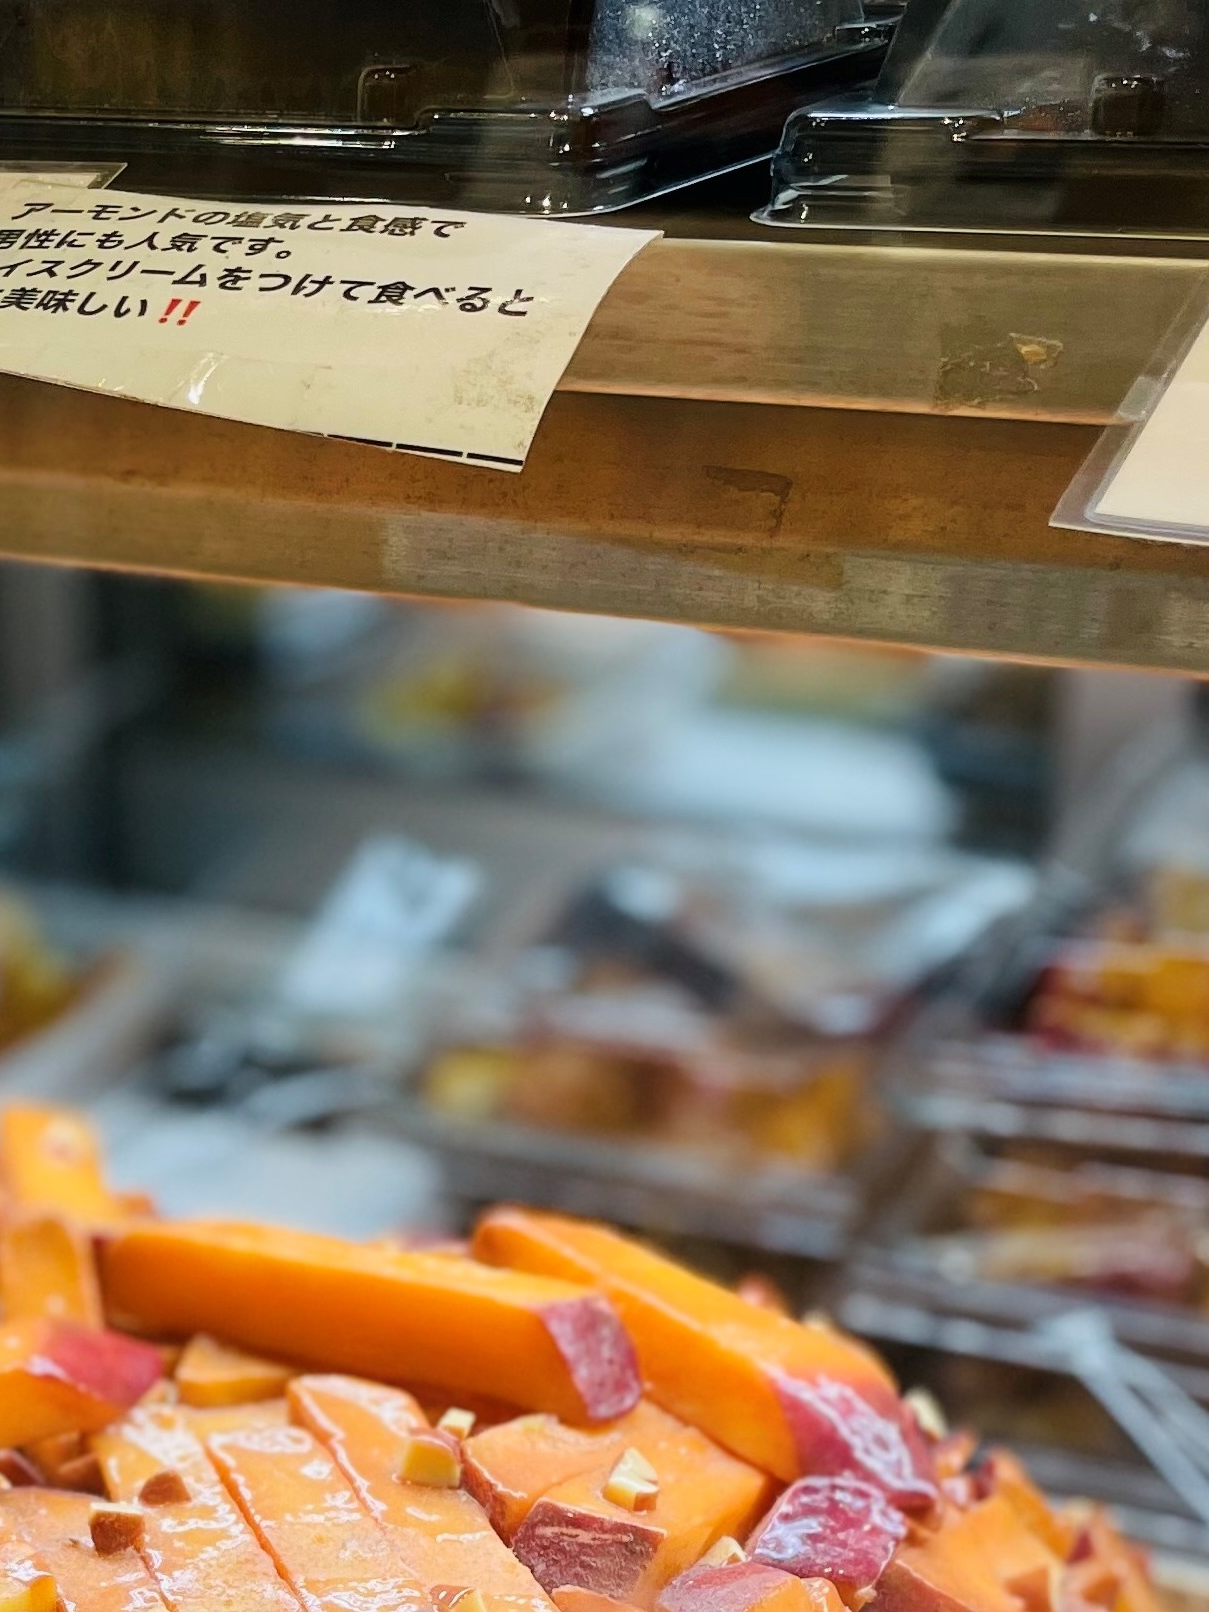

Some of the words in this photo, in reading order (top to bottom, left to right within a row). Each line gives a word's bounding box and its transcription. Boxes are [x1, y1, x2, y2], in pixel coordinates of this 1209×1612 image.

[11, 203, 467, 238] アーモンドの塩気と食感で
